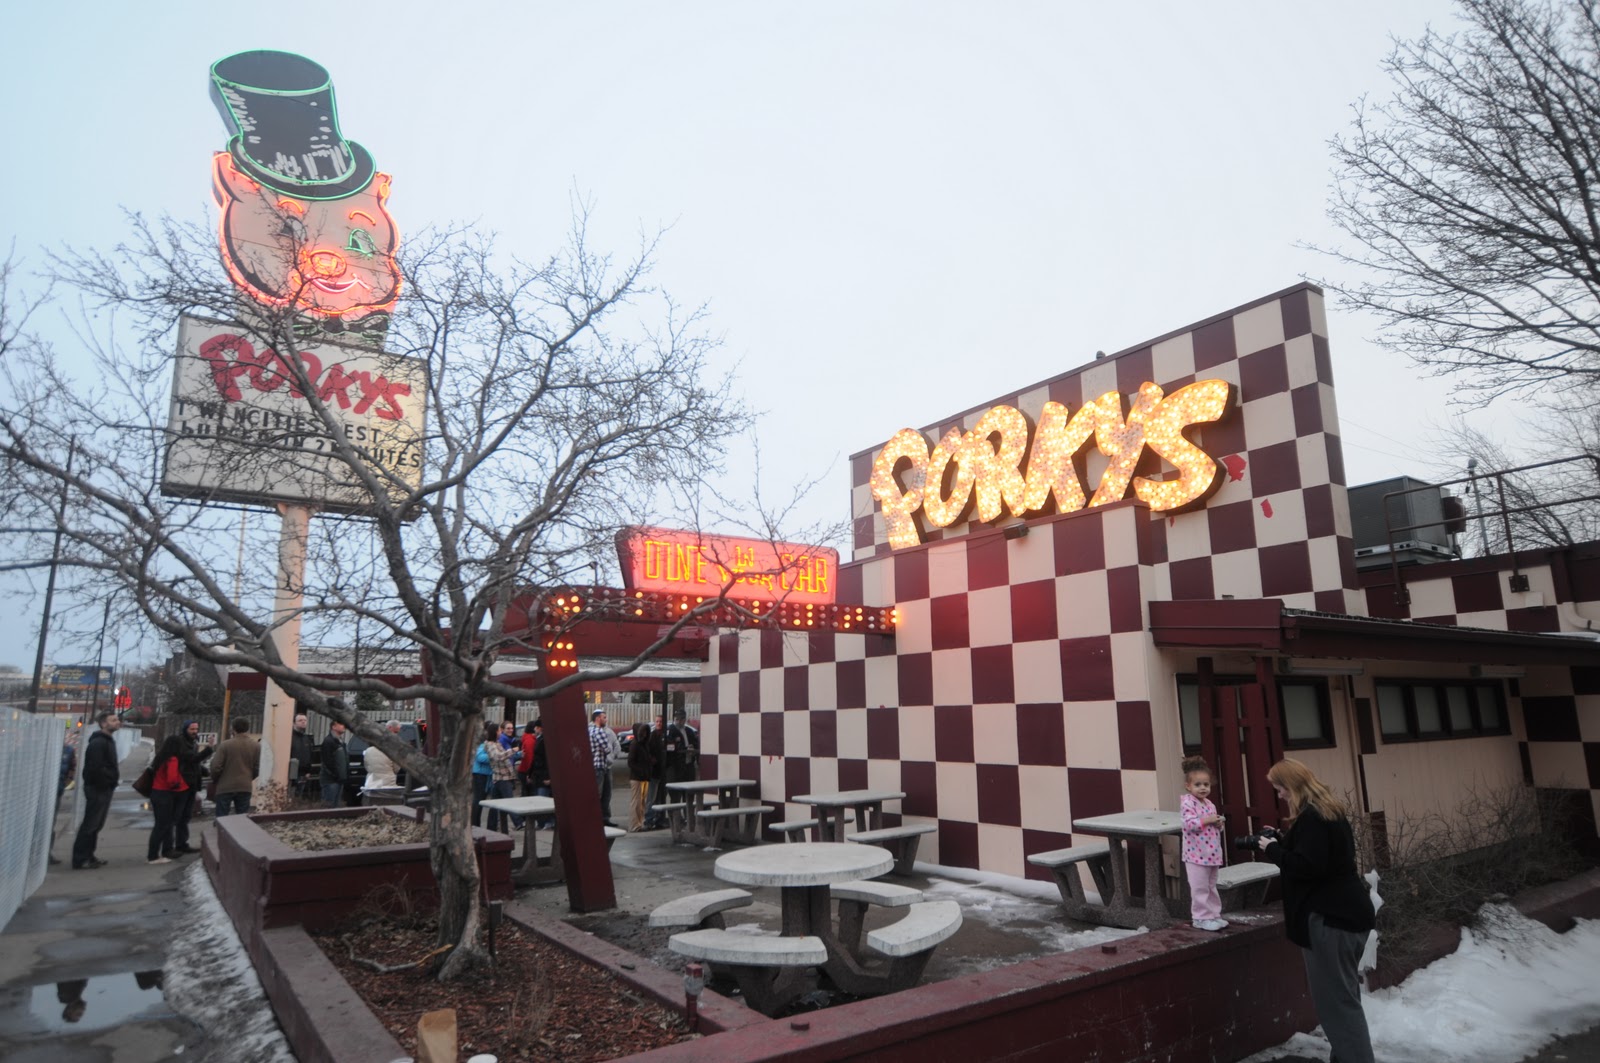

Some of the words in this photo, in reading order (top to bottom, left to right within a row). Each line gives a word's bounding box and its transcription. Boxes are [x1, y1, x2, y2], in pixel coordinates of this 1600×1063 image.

[198, 332, 412, 421] PORKYS
[869, 378, 1230, 552] PORKYS
[645, 540, 708, 584] DINE
[735, 546, 755, 568] IN
[780, 552, 828, 594] CAR
